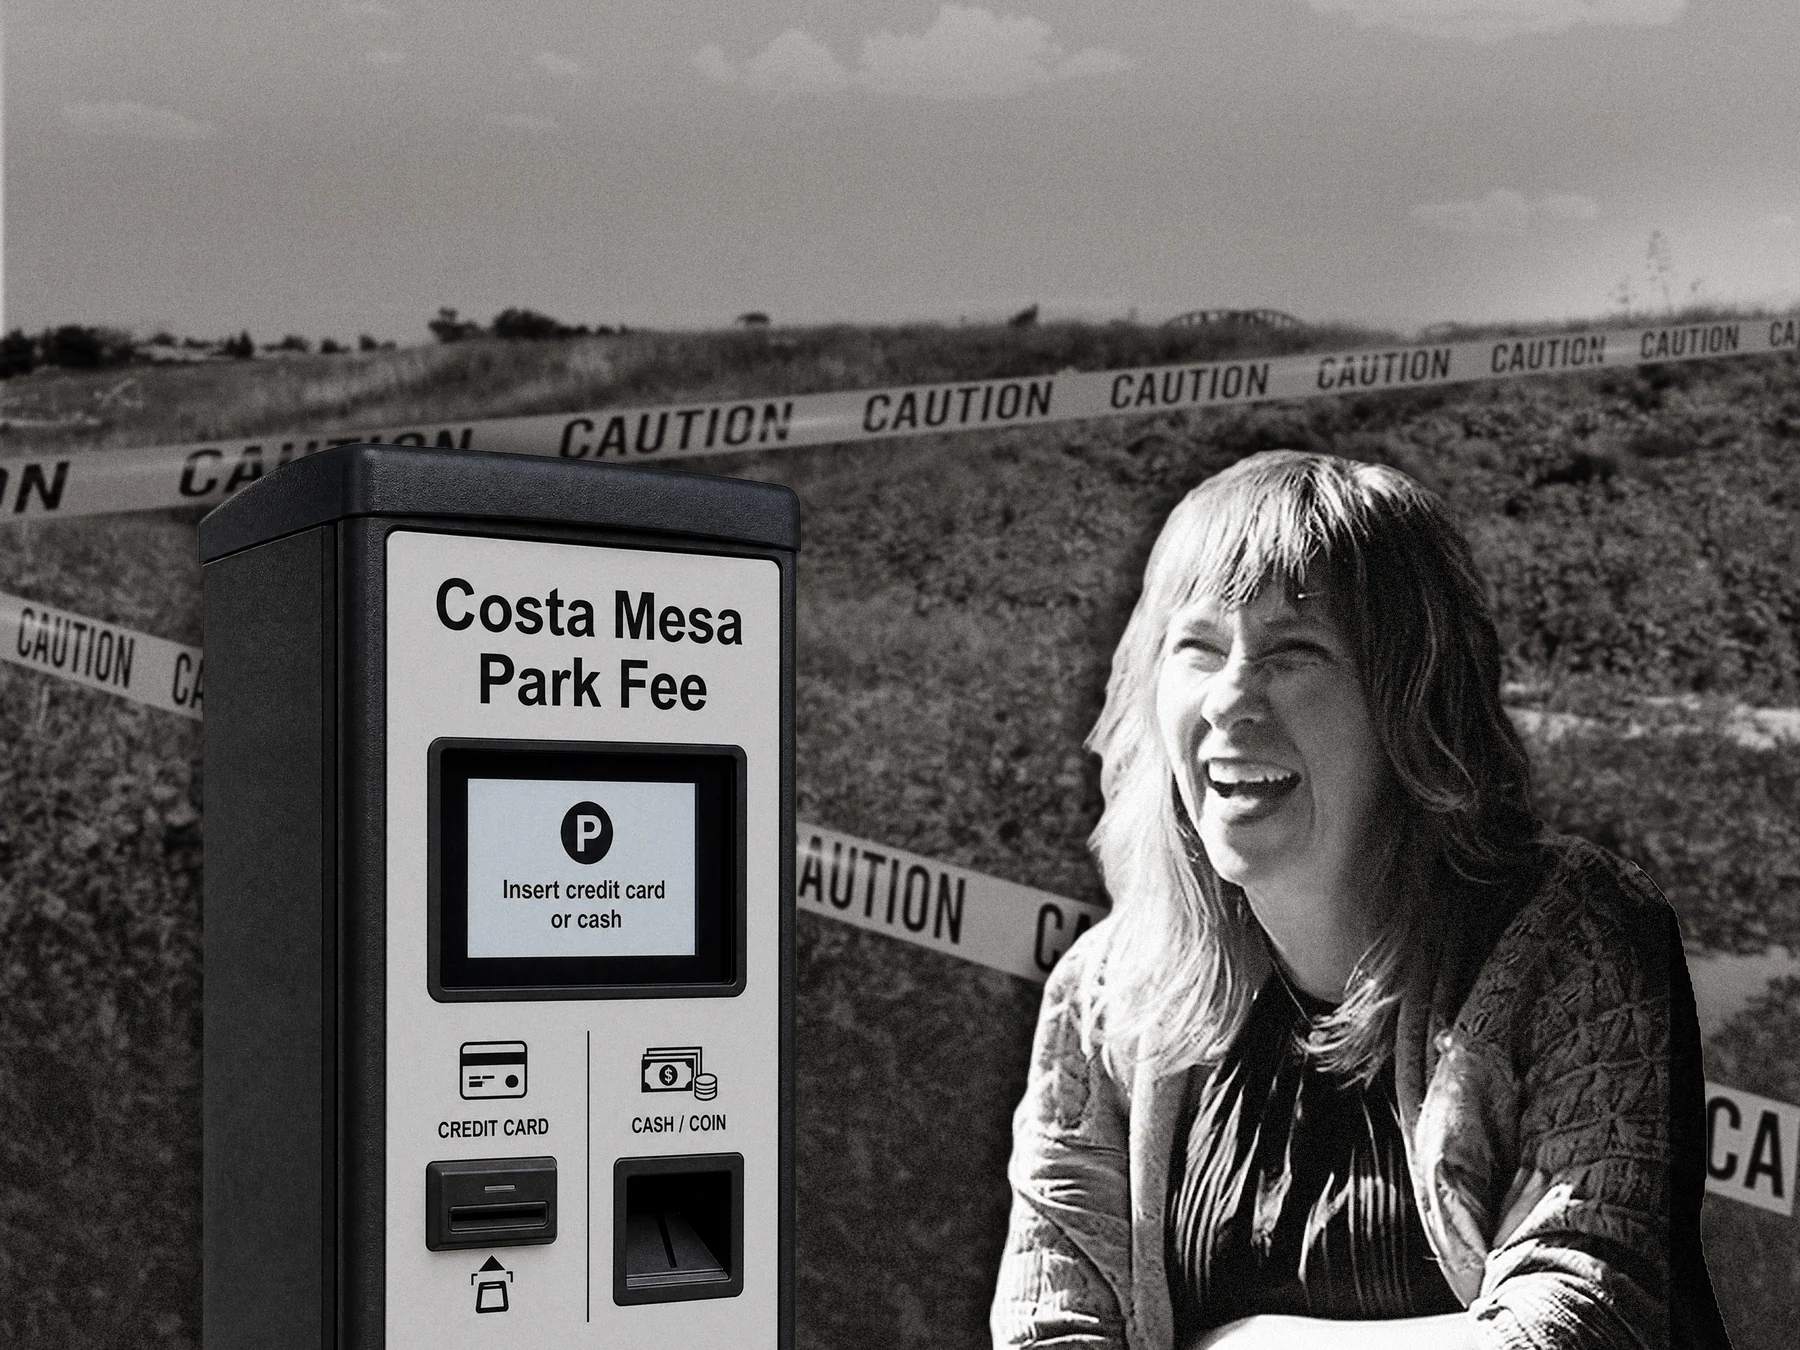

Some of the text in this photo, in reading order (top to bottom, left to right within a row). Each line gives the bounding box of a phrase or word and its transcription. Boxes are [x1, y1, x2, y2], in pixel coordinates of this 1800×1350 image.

[559, 402, 793, 459] CAUTION
[862, 381, 1053, 433] CAUTION
[1110, 363, 1269, 409] CAUTION
[1317, 350, 1451, 390] CAUTION
[1491, 336, 1605, 374] CAUTION
[1640, 325, 1739, 359] CAUTION
[437, 578, 743, 645] Costa Mesa
[480, 653, 707, 711] Park Fee
[576, 814, 602, 852] P
[17, 608, 135, 689] CAUTION
[797, 835, 966, 944] AUTION
[1706, 1096, 1784, 1198] CA
[503, 879, 665, 900] Insert credit card
[550, 909, 622, 929] or cash
[437, 1117, 549, 1139] CREDIT CARD
[631, 1116, 674, 1134] CASH
[689, 1114, 726, 1132] COIN
